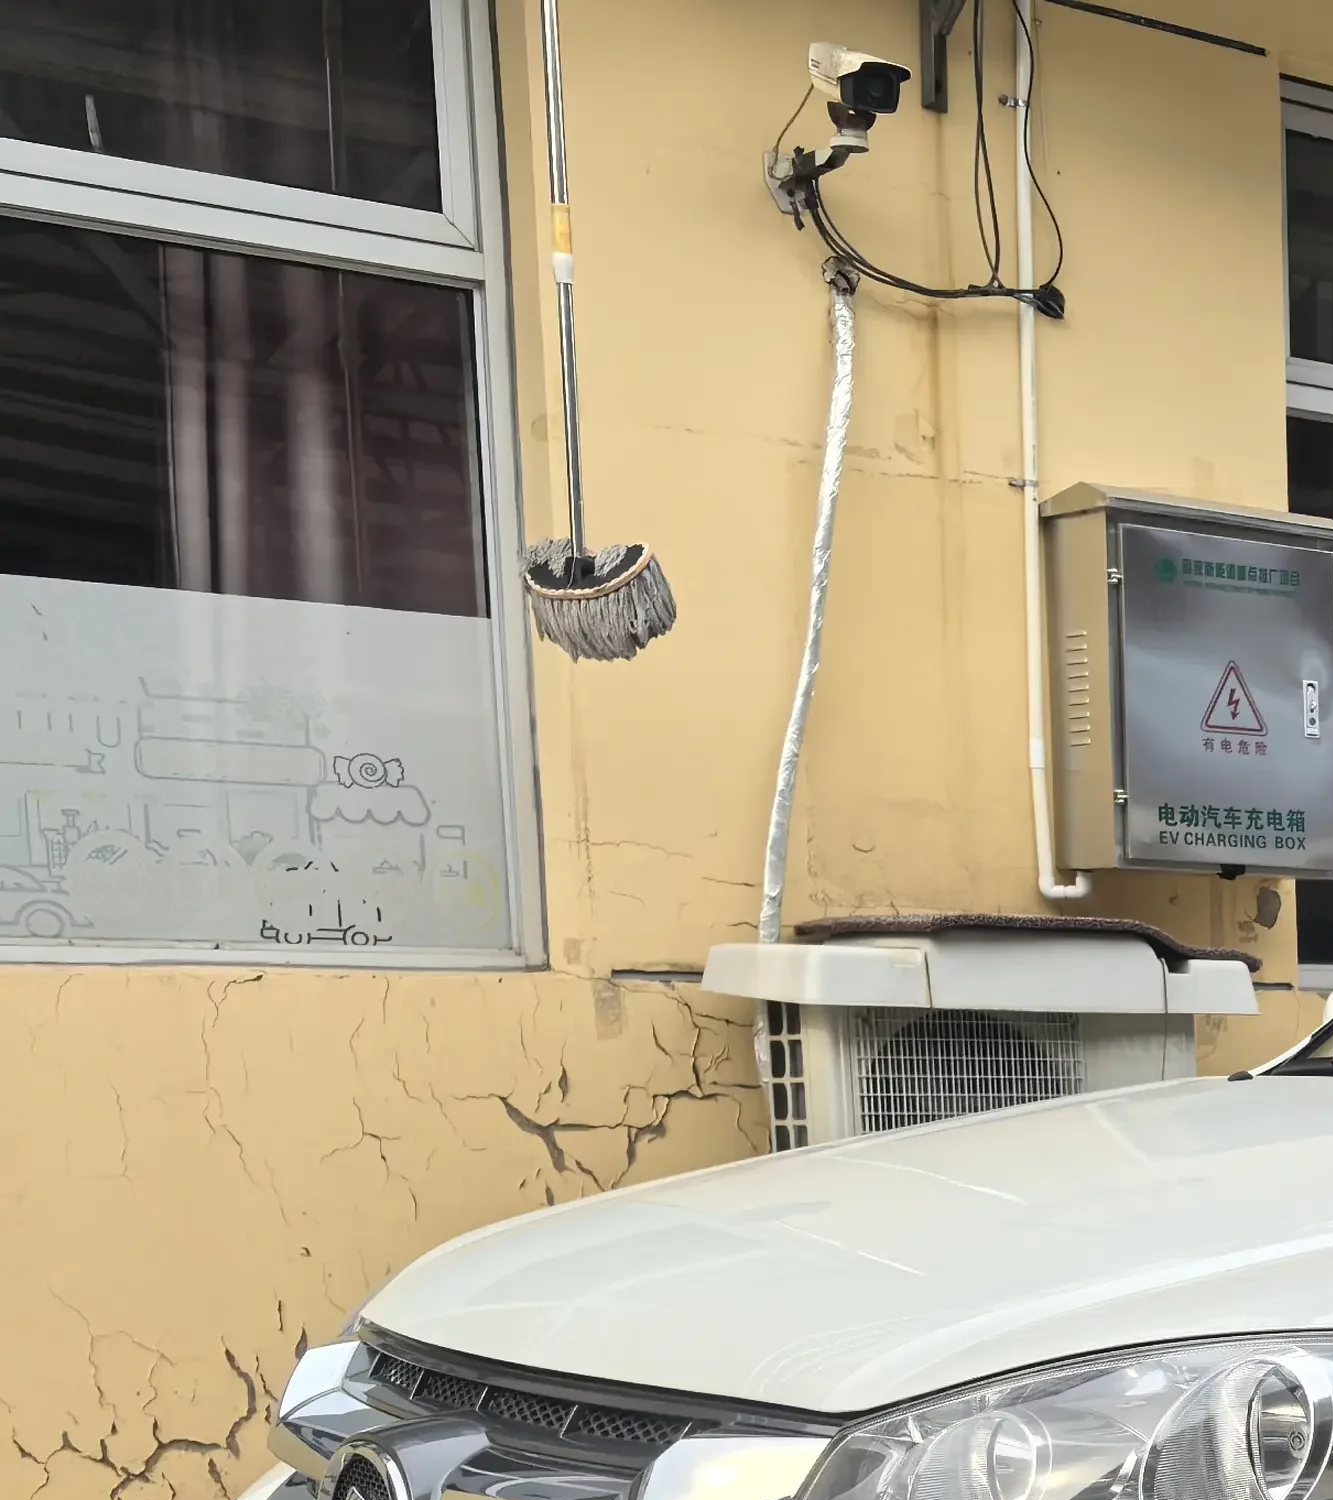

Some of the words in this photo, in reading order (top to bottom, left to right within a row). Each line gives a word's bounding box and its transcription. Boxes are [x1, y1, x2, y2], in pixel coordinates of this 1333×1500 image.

[1202, 737, 1268, 756] 有电危险
[1157, 803, 1306, 833] 电动汽车充电箱
[1159, 830, 1179, 845] EV
[1184, 832, 1267, 849] CHARGING
[1275, 836, 1306, 850] BOX
